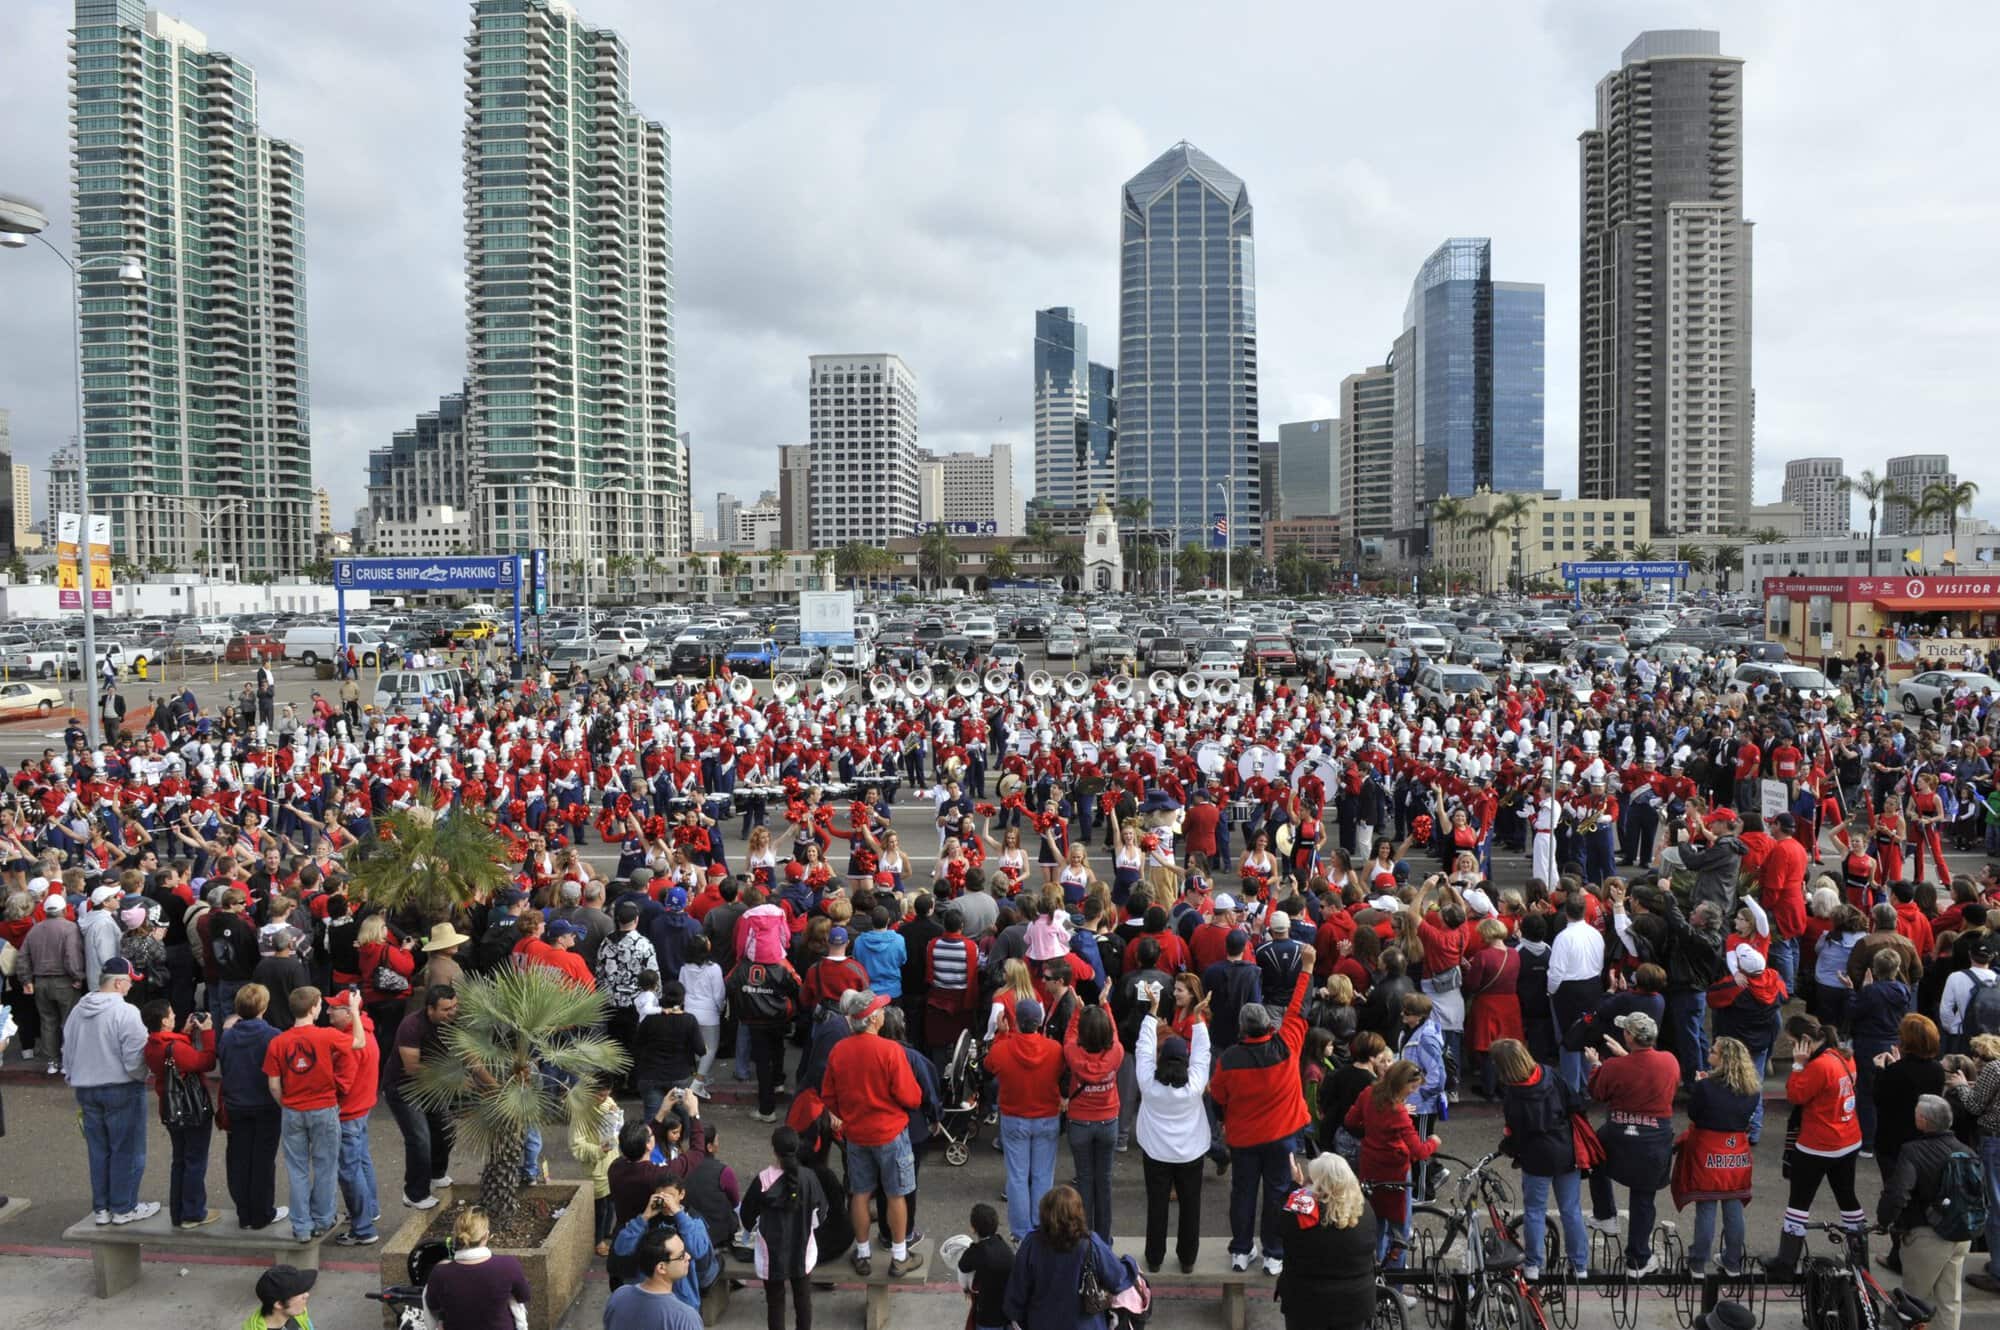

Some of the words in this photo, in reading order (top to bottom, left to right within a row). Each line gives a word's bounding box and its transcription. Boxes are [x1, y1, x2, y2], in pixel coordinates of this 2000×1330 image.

[976, 522, 994, 534] Fe
[356, 567, 395, 580] CRUISE
[396, 567, 420, 580] SHIP
[450, 566, 496, 580] PARKING
[1575, 566, 1603, 574] CRUISE
[1604, 566, 1621, 574] SHIP
[1641, 566, 1675, 574] PARKING
[1568, 580, 1575, 589] P
[1806, 584, 1844, 592] INFORMATION
[1936, 584, 1991, 594] VISITOR
[537, 593, 544, 610] P
[1704, 1152, 1752, 1168] ARIZON
